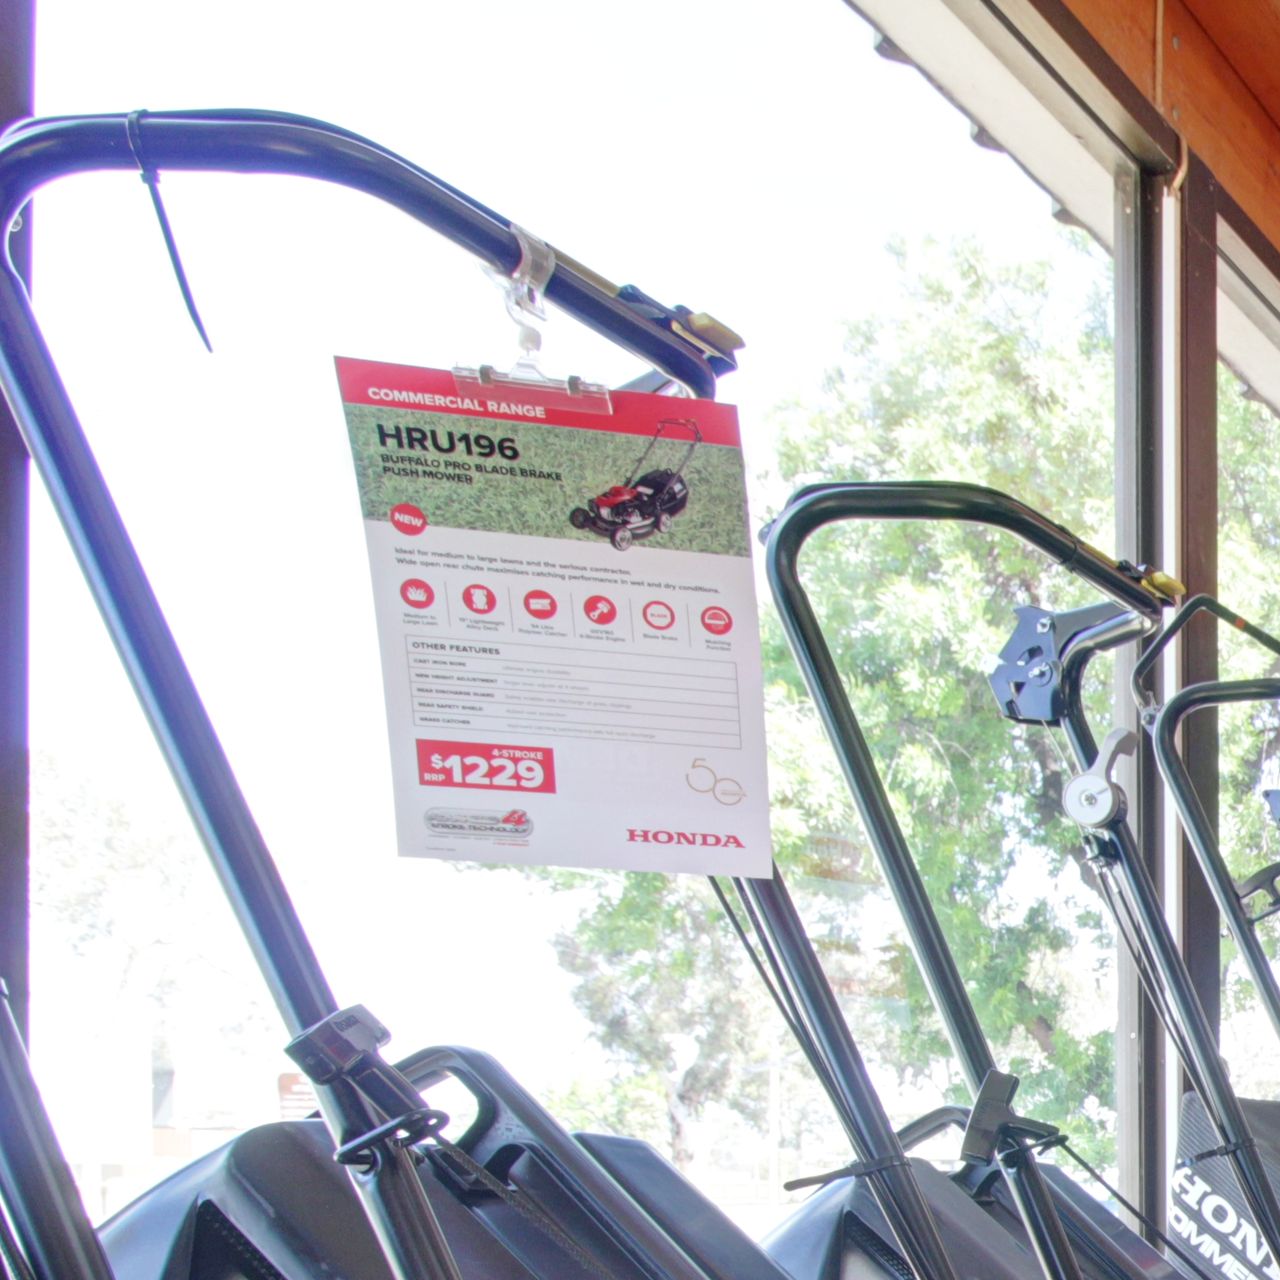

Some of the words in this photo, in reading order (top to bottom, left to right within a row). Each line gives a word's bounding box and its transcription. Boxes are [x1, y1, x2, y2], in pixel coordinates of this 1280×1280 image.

[368, 387, 483, 411] COMMERCIAL
[486, 401, 546, 418] RANGE
[377, 423, 520, 460] HRU196
[380, 453, 441, 469] BUFFALO
[444, 459, 471, 471] PRO
[474, 463, 518, 477] BLADE
[519, 468, 562, 482] BRAKE
[383, 465, 419, 478] PUSH
[422, 470, 473, 484] MOWER
[393, 511, 423, 527] NEW
[395, 557, 417, 565] Wide
[420, 560, 441, 570] open
[532, 570, 566, 581] catching
[568, 575, 618, 586] performance
[431, 551, 464, 559] medium
[477, 553, 497, 564] large
[500, 557, 524, 565] lawns
[559, 563, 588, 572] serious
[411, 641, 447, 652] OTHER
[449, 644, 501, 656] FEATURES
[492, 749, 544, 760] 4-STROKE
[424, 773, 446, 782] RRP
[430, 753, 545, 788] $1229
[626, 828, 745, 848] HONDA
